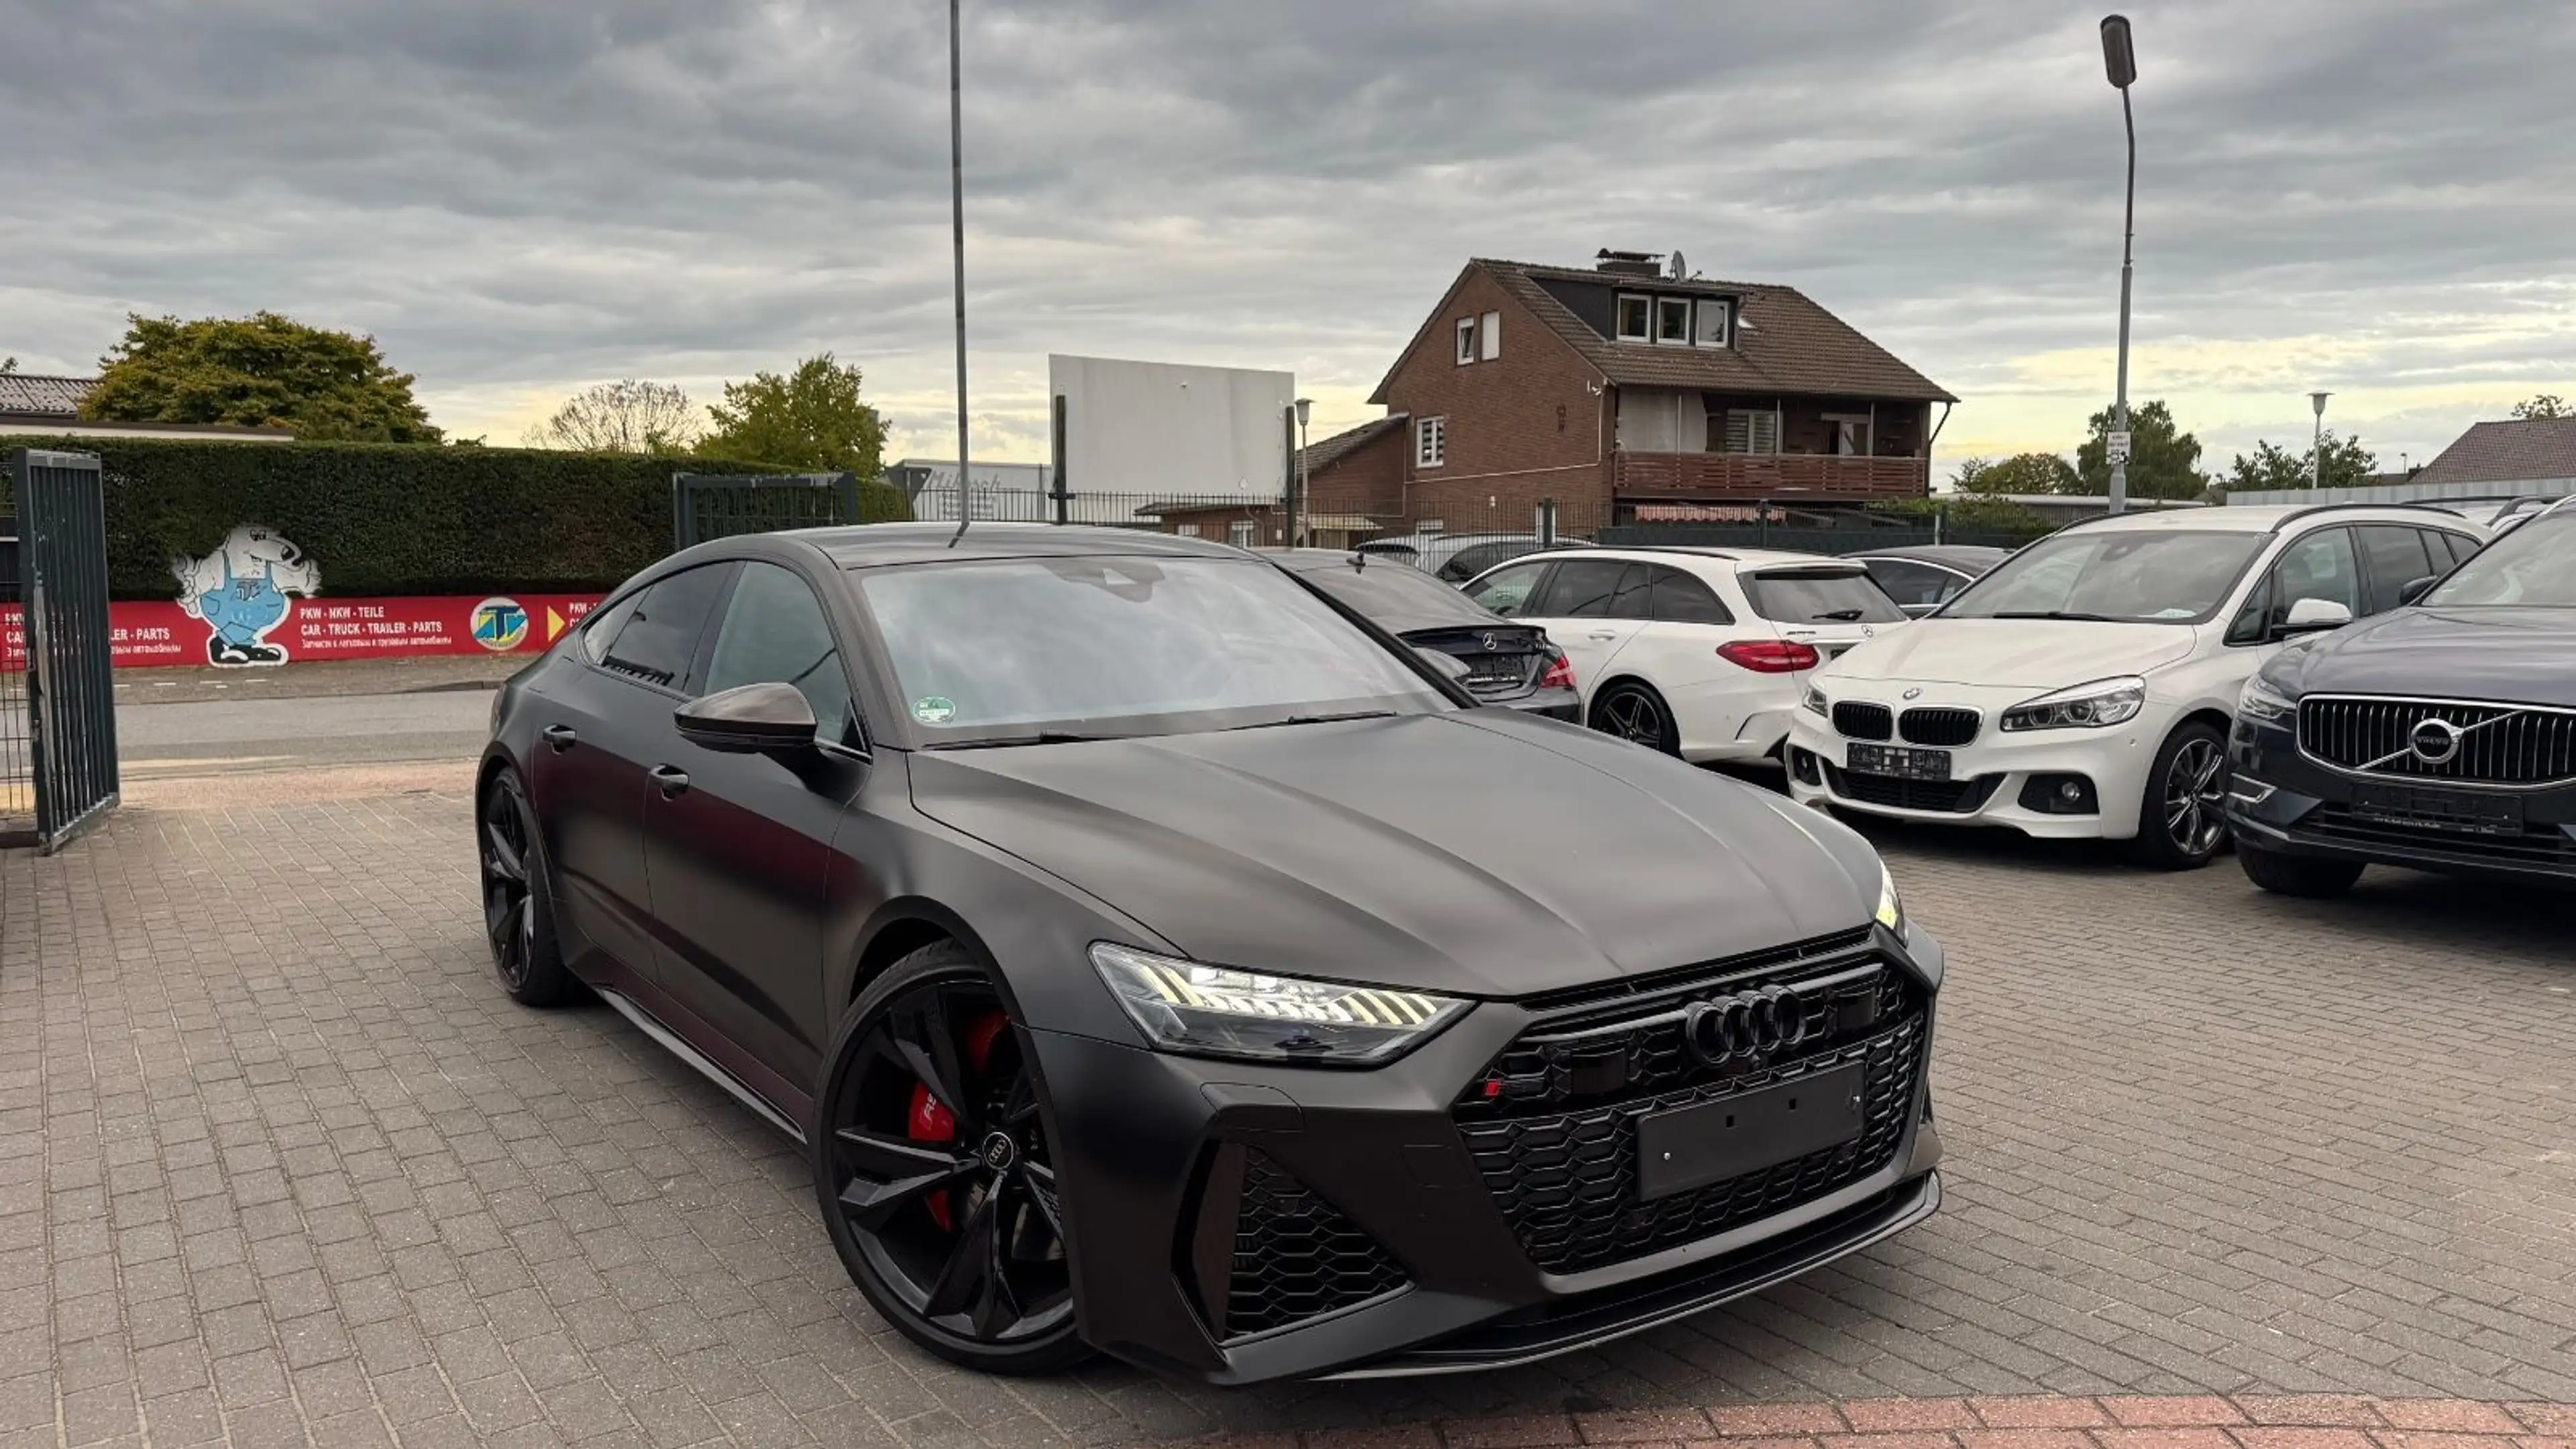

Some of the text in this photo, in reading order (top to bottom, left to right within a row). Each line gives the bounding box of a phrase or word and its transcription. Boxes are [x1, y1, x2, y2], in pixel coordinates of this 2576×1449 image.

[358, 606, 384, 618] TEILE
[137, 628, 170, 641] PARTS
[301, 621, 443, 636] CAR TRUCK TRAILER PARTS
[2416, 735, 2449, 746] VOLVO
